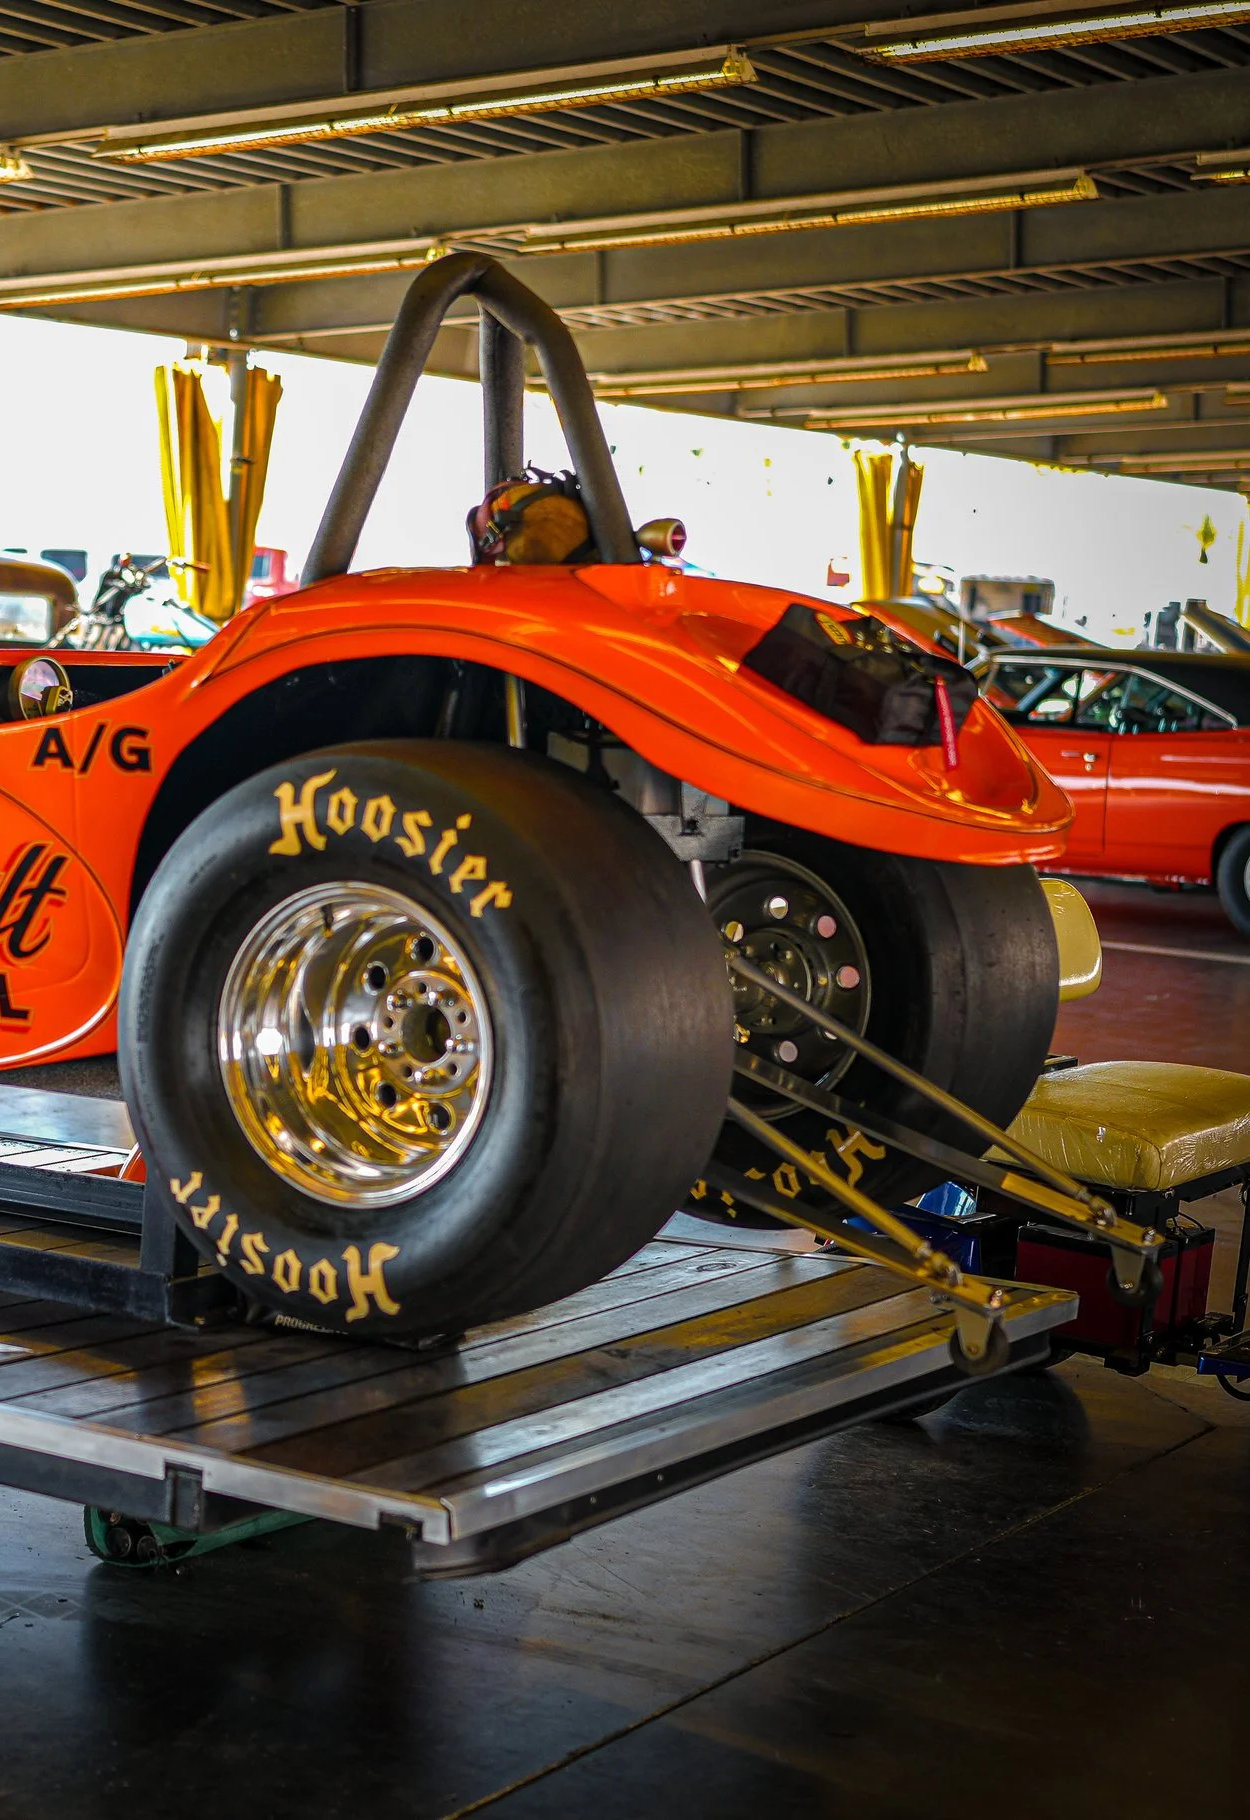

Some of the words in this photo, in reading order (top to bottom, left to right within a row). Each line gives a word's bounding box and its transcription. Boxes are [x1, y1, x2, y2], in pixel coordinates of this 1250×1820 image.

[31, 719, 154, 774] A/G
[268, 767, 514, 919] Hoosier
[169, 1170, 401, 1323] Hoosier
